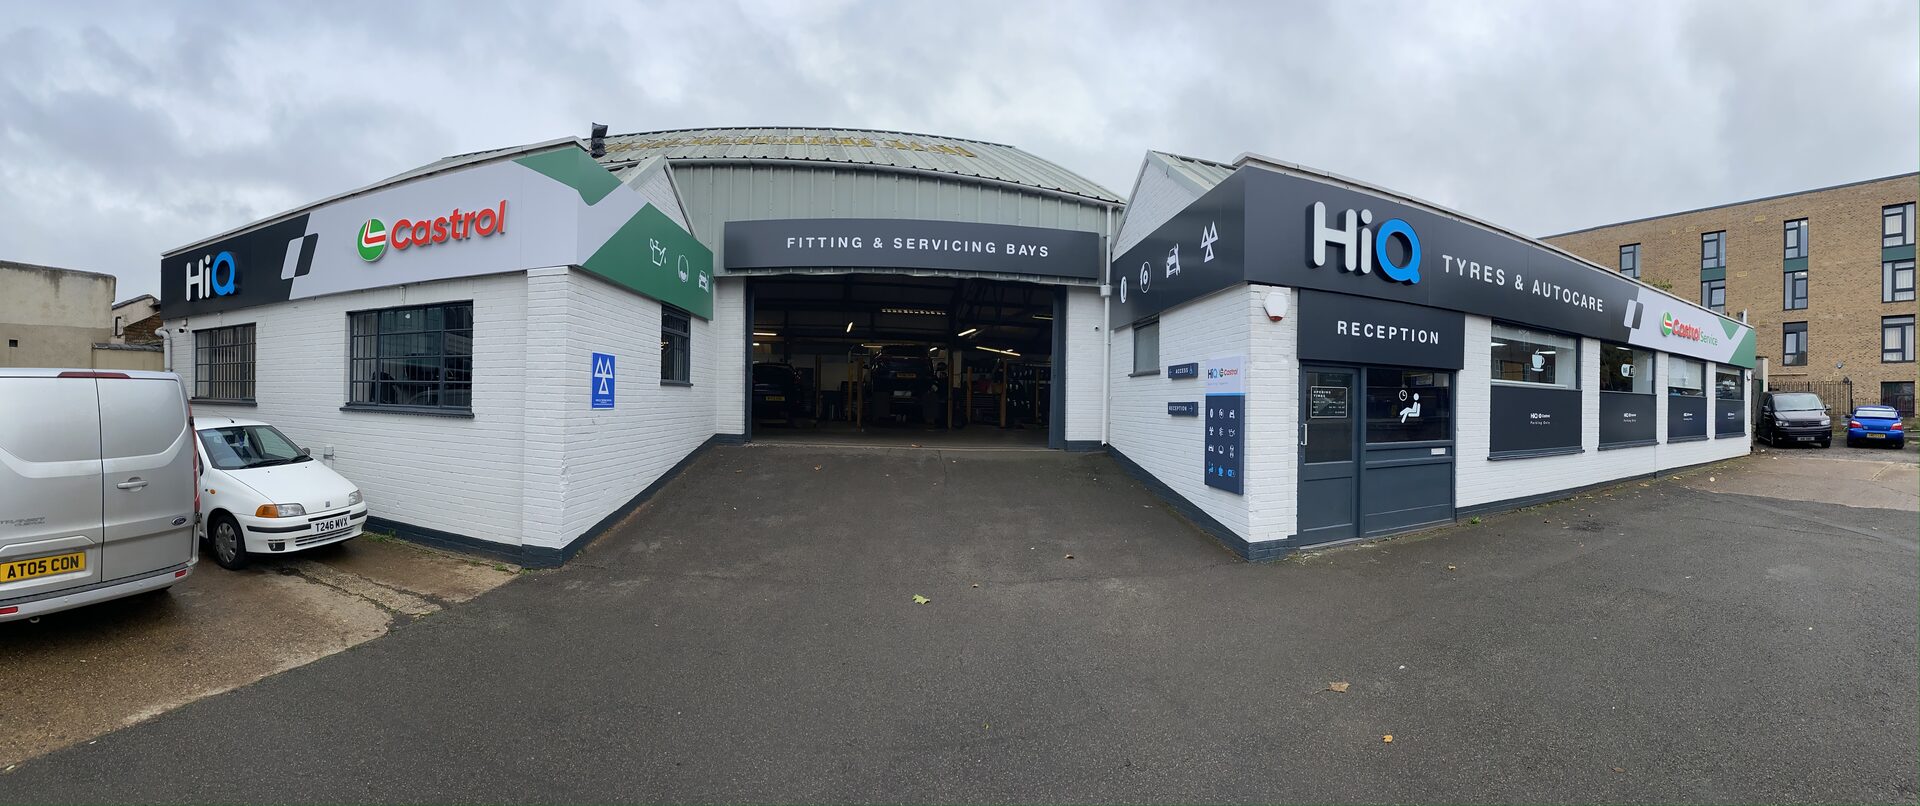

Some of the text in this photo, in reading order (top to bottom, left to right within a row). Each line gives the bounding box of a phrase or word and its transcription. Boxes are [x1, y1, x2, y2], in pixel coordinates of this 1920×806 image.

[391, 199, 508, 250] Castrol
[786, 236, 1050, 258] FITTING & SERVICING BAYS
[1312, 201, 1422, 284] HiQ
[186, 250, 237, 302] HiQ
[1442, 254, 1604, 313] TYRES & AUTOCARE
[1337, 320, 1440, 345] RECEPTION
[1673, 319, 1718, 346] Castrol Service
[315, 515, 349, 533] T246 MVX
[6, 554, 80, 579] AT05 CON
